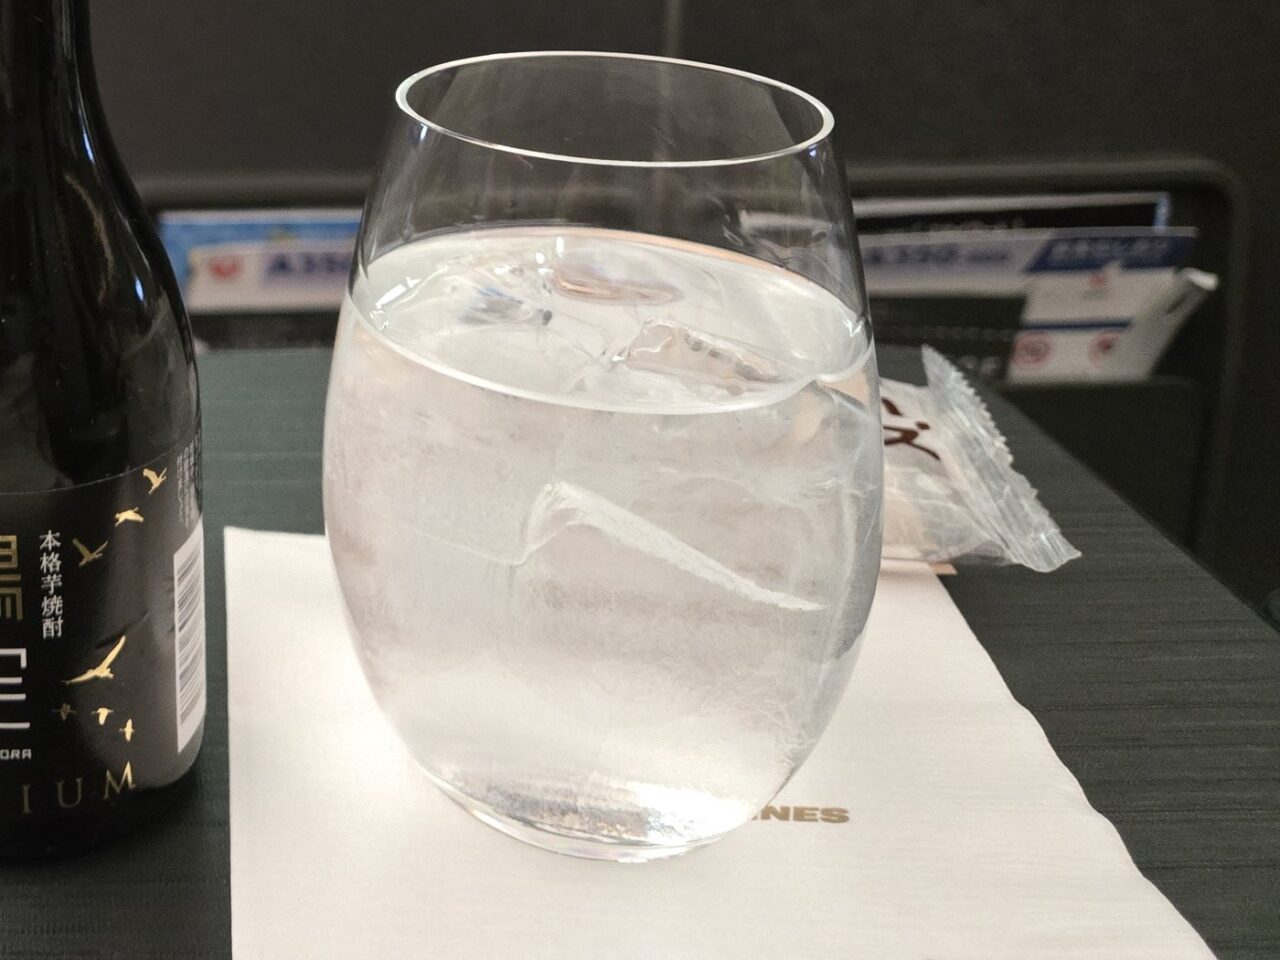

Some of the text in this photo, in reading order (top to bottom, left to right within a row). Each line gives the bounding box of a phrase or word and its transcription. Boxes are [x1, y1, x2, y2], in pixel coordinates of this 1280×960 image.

[39, 529, 64, 639] 本格芋焼酎
[751, 805, 850, 824] NES
